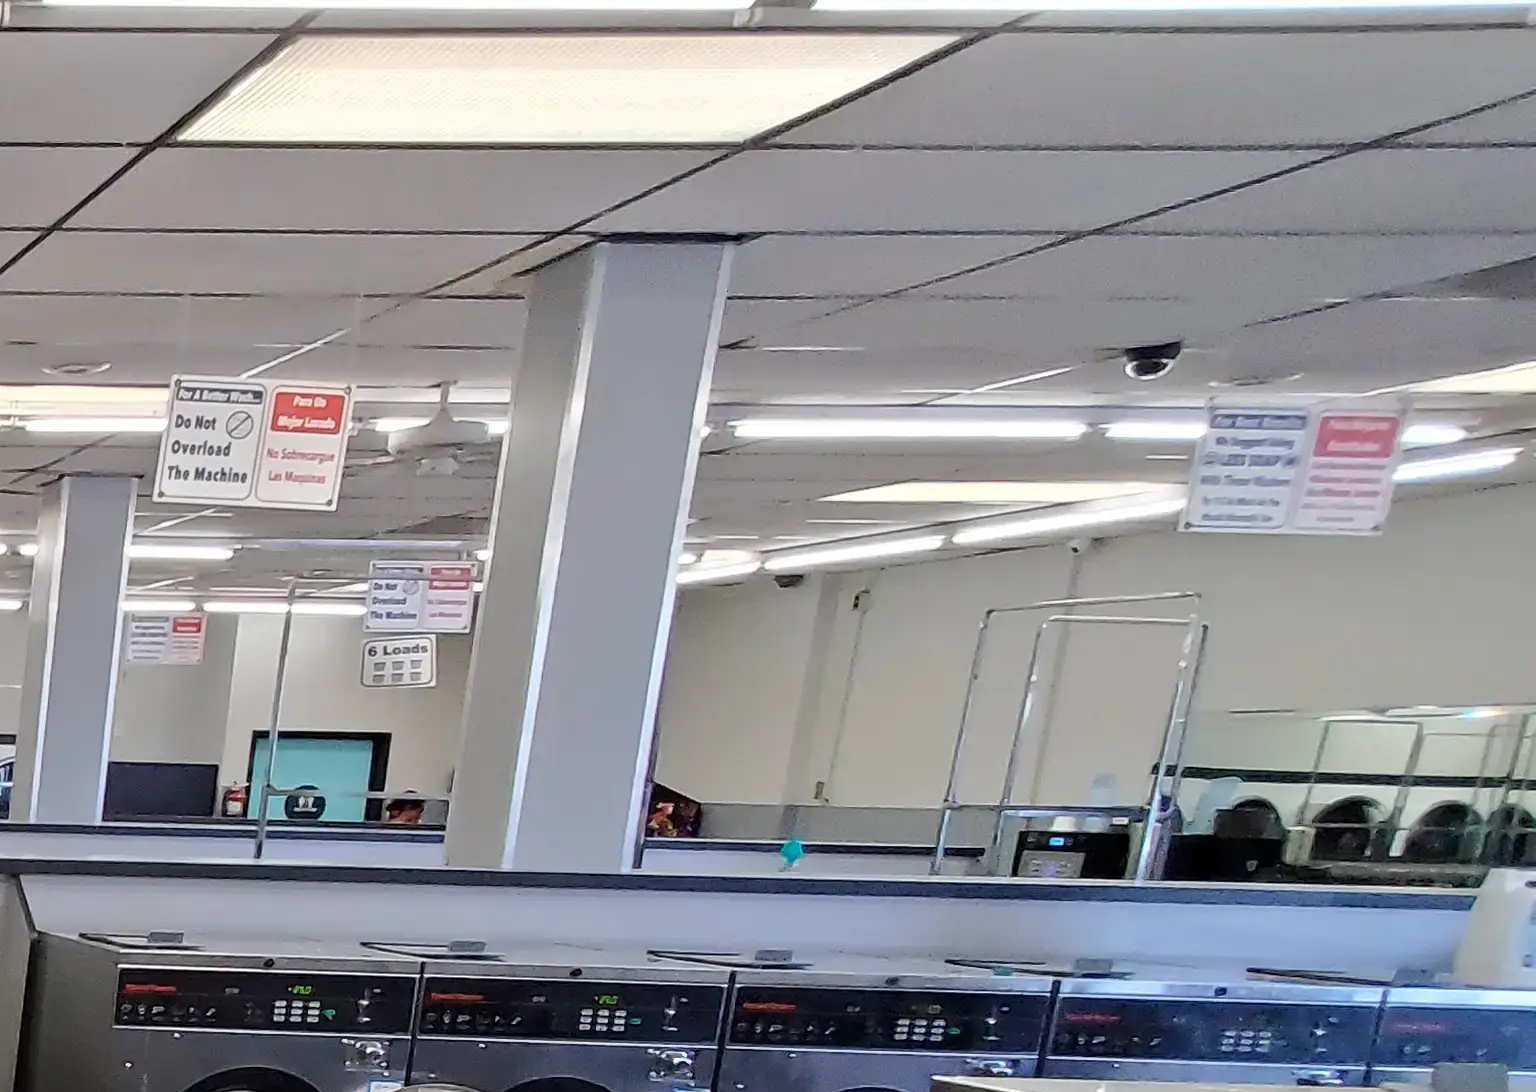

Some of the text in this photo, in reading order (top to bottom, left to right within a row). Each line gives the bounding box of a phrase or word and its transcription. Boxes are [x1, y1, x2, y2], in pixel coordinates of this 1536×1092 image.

[174, 413, 216, 431] Do Not
[171, 439, 232, 457] Overload
[168, 465, 248, 484] The Machine
[368, 643, 429, 657] 6 Loads
